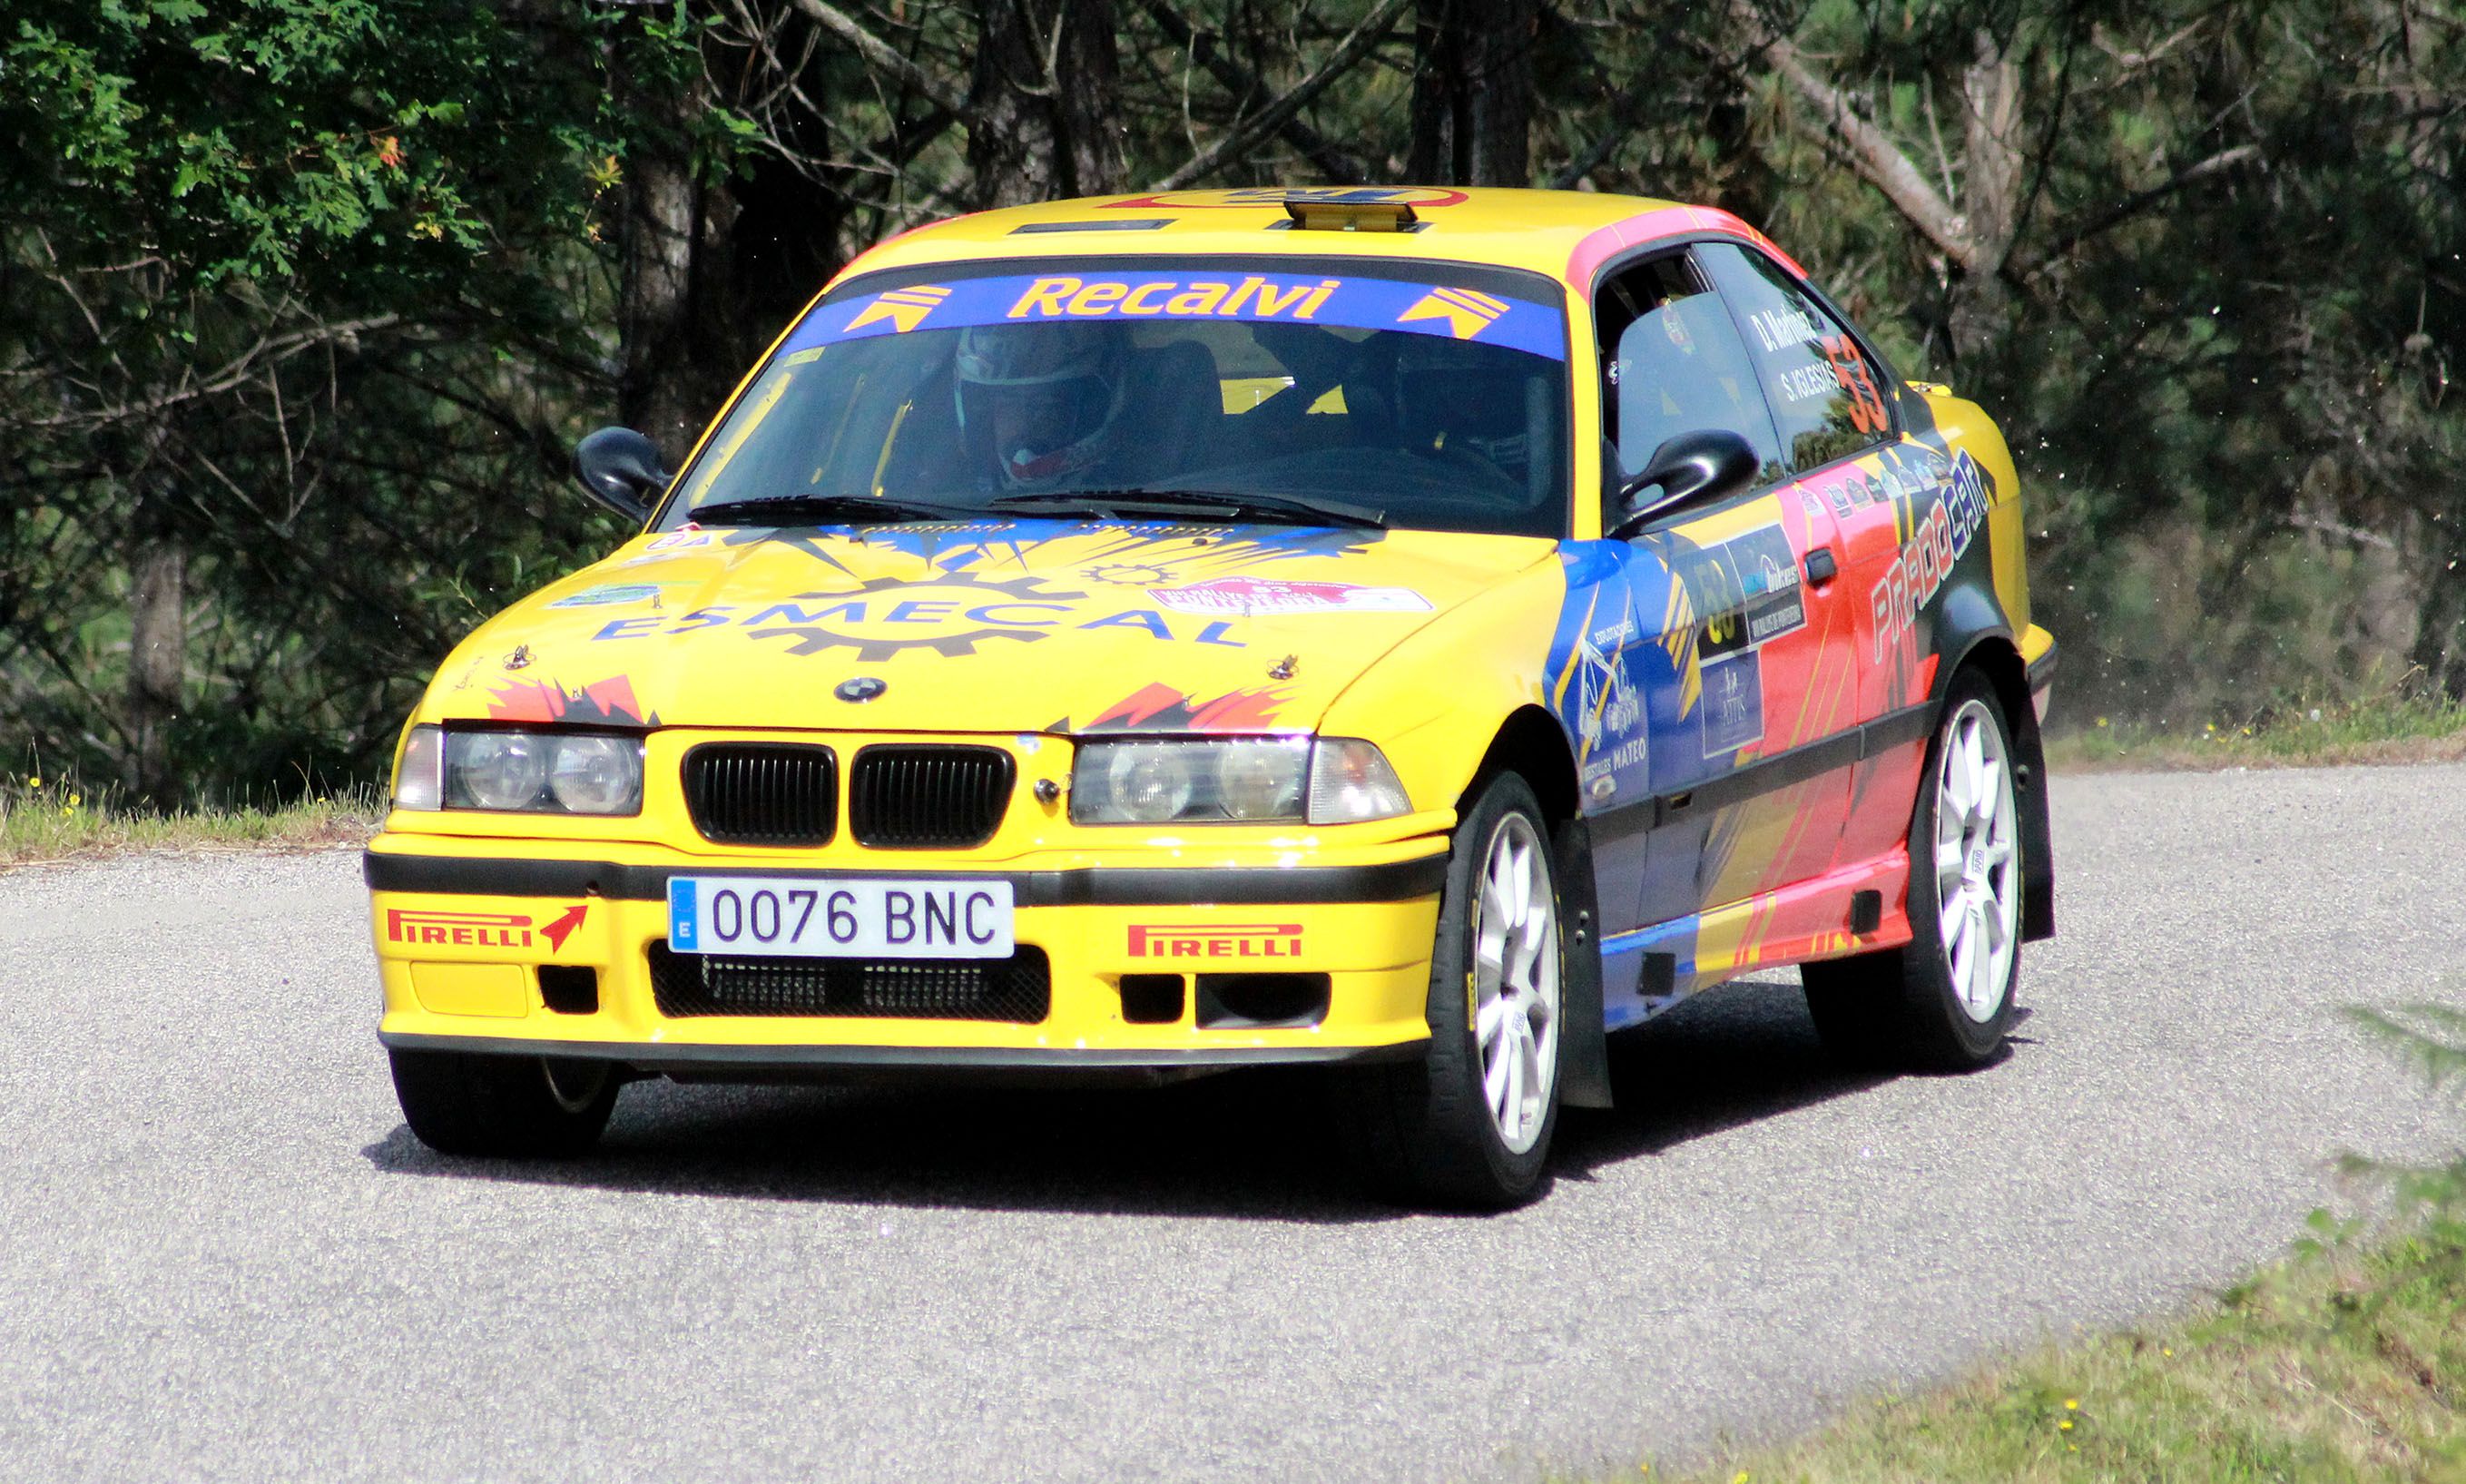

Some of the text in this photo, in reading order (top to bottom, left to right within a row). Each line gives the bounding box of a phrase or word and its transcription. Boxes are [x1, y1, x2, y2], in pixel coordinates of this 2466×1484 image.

[1007, 276, 1341, 319] Recalvi
[1821, 332, 1889, 434] 53
[1872, 447, 1989, 664] PRADOCAR
[591, 601, 1248, 648] ESMECAL
[1613, 737, 1646, 771] MATEO
[387, 909, 533, 948] PIRELLI
[679, 921, 691, 938] E
[713, 889, 997, 946] 0076 BNC
[1127, 924, 1304, 957] PIRELLI
